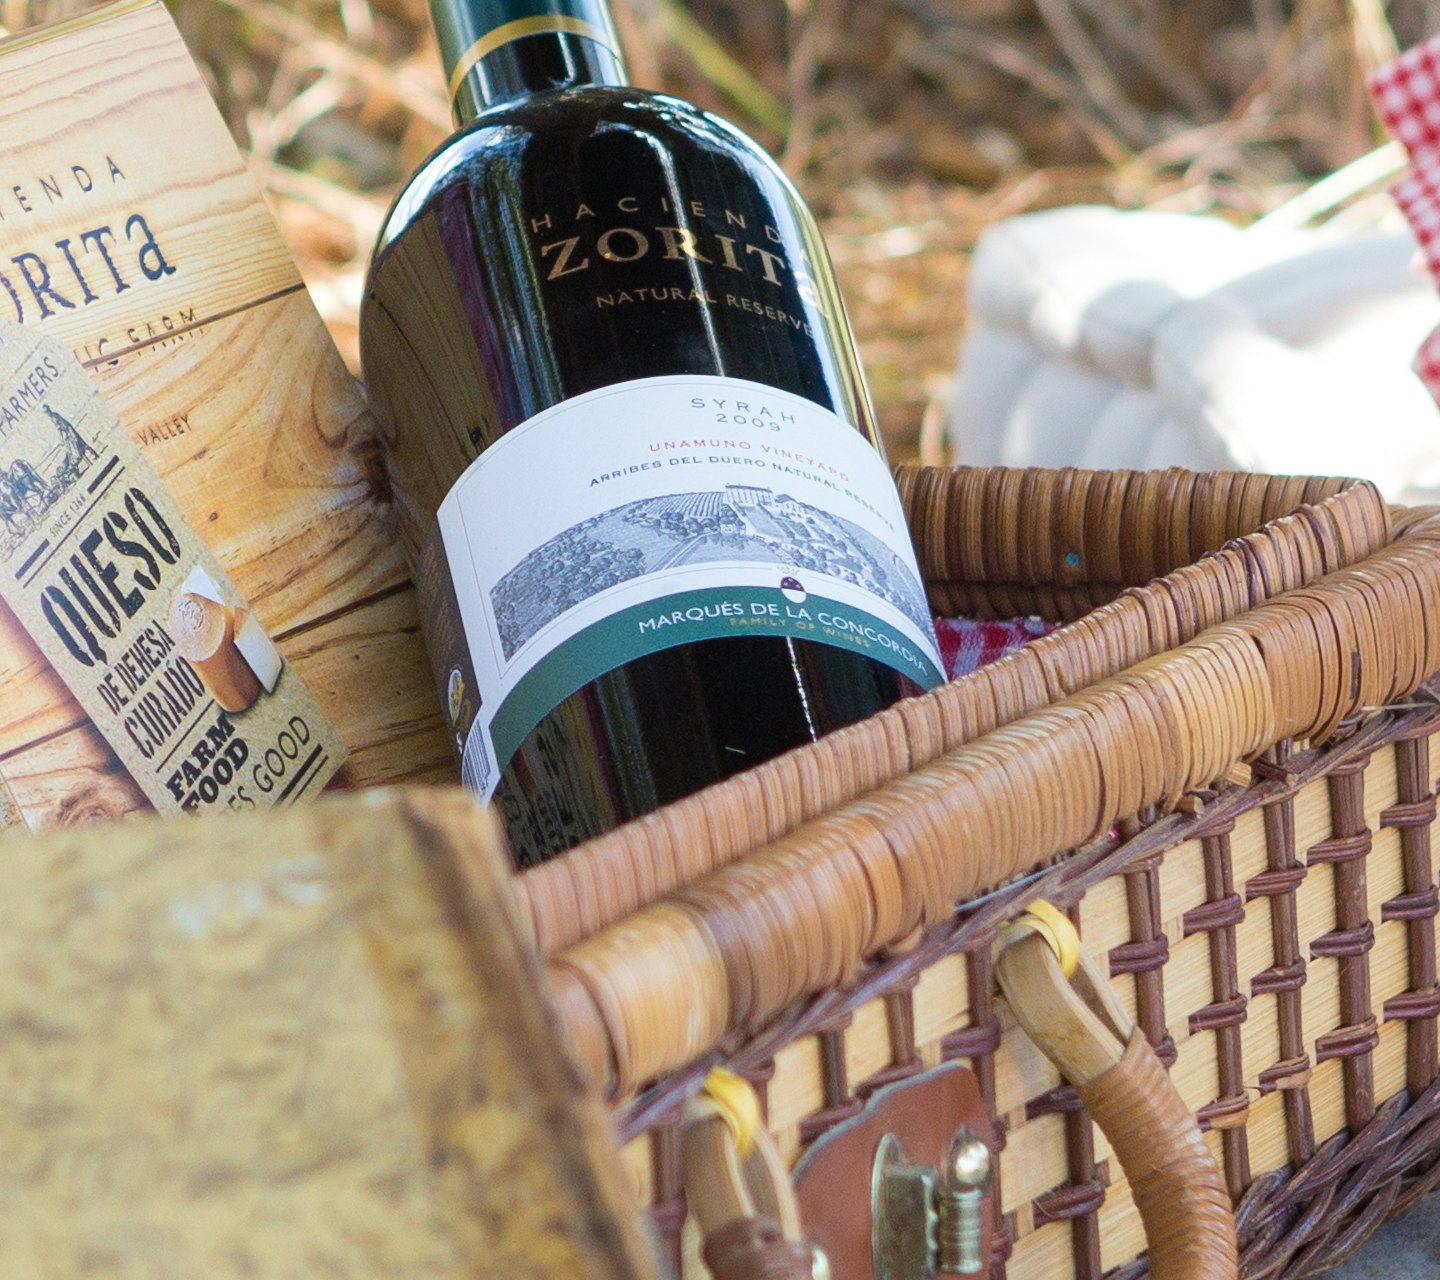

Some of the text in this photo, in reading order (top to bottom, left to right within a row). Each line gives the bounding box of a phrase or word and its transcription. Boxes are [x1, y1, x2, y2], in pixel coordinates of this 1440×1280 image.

[596, 287, 814, 338] NATURAL RESERVE
[137, 414, 193, 447] VALLEY
[691, 397, 796, 425] SYRAH
[716, 413, 781, 432] 2009
[589, 460, 662, 487] ARRIBES
[669, 455, 702, 466] DEL
[709, 455, 766, 468] DUERO
[773, 462, 840, 492] NATURAL
[649, 439, 850, 482] UNAMUNO VINEYARD
[40, 487, 181, 667] QUESO
[97, 619, 176, 716] DE DEHESA
[638, 600, 929, 676] MARQUÉS DE LA CONCORDIA
[124, 656, 206, 760] CURADO
[165, 714, 236, 803] FARM
[180, 738, 249, 814] FOOD
[253, 716, 311, 793] GOOD
